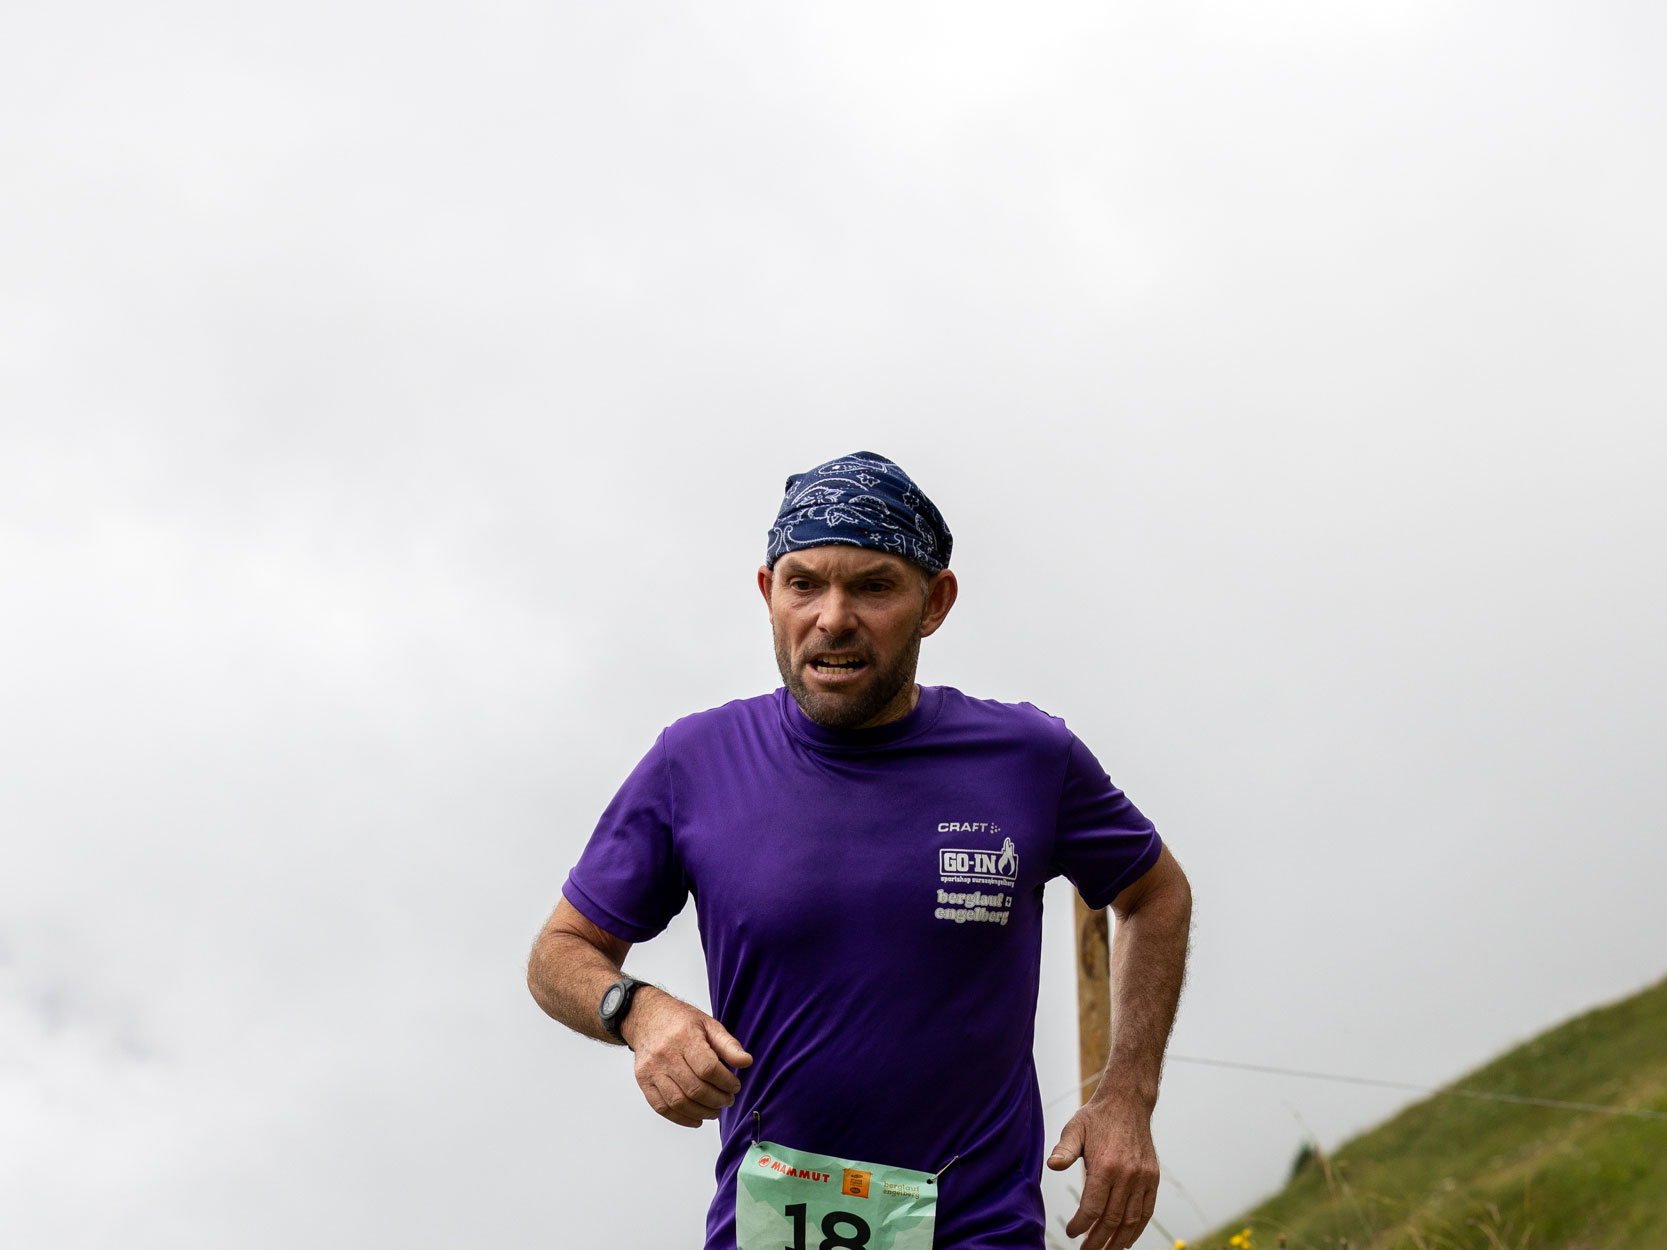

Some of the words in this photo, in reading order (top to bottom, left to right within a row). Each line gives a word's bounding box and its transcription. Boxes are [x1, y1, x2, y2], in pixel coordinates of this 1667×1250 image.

[938, 822, 988, 832] CRAFT
[943, 852, 997, 873] GO-IN
[940, 876, 971, 884] sportshop
[937, 888, 1004, 908] berglauf
[934, 907, 1010, 926] engelberg
[770, 1160, 831, 1184] MAMMUT
[883, 1181, 920, 1192] berglauf
